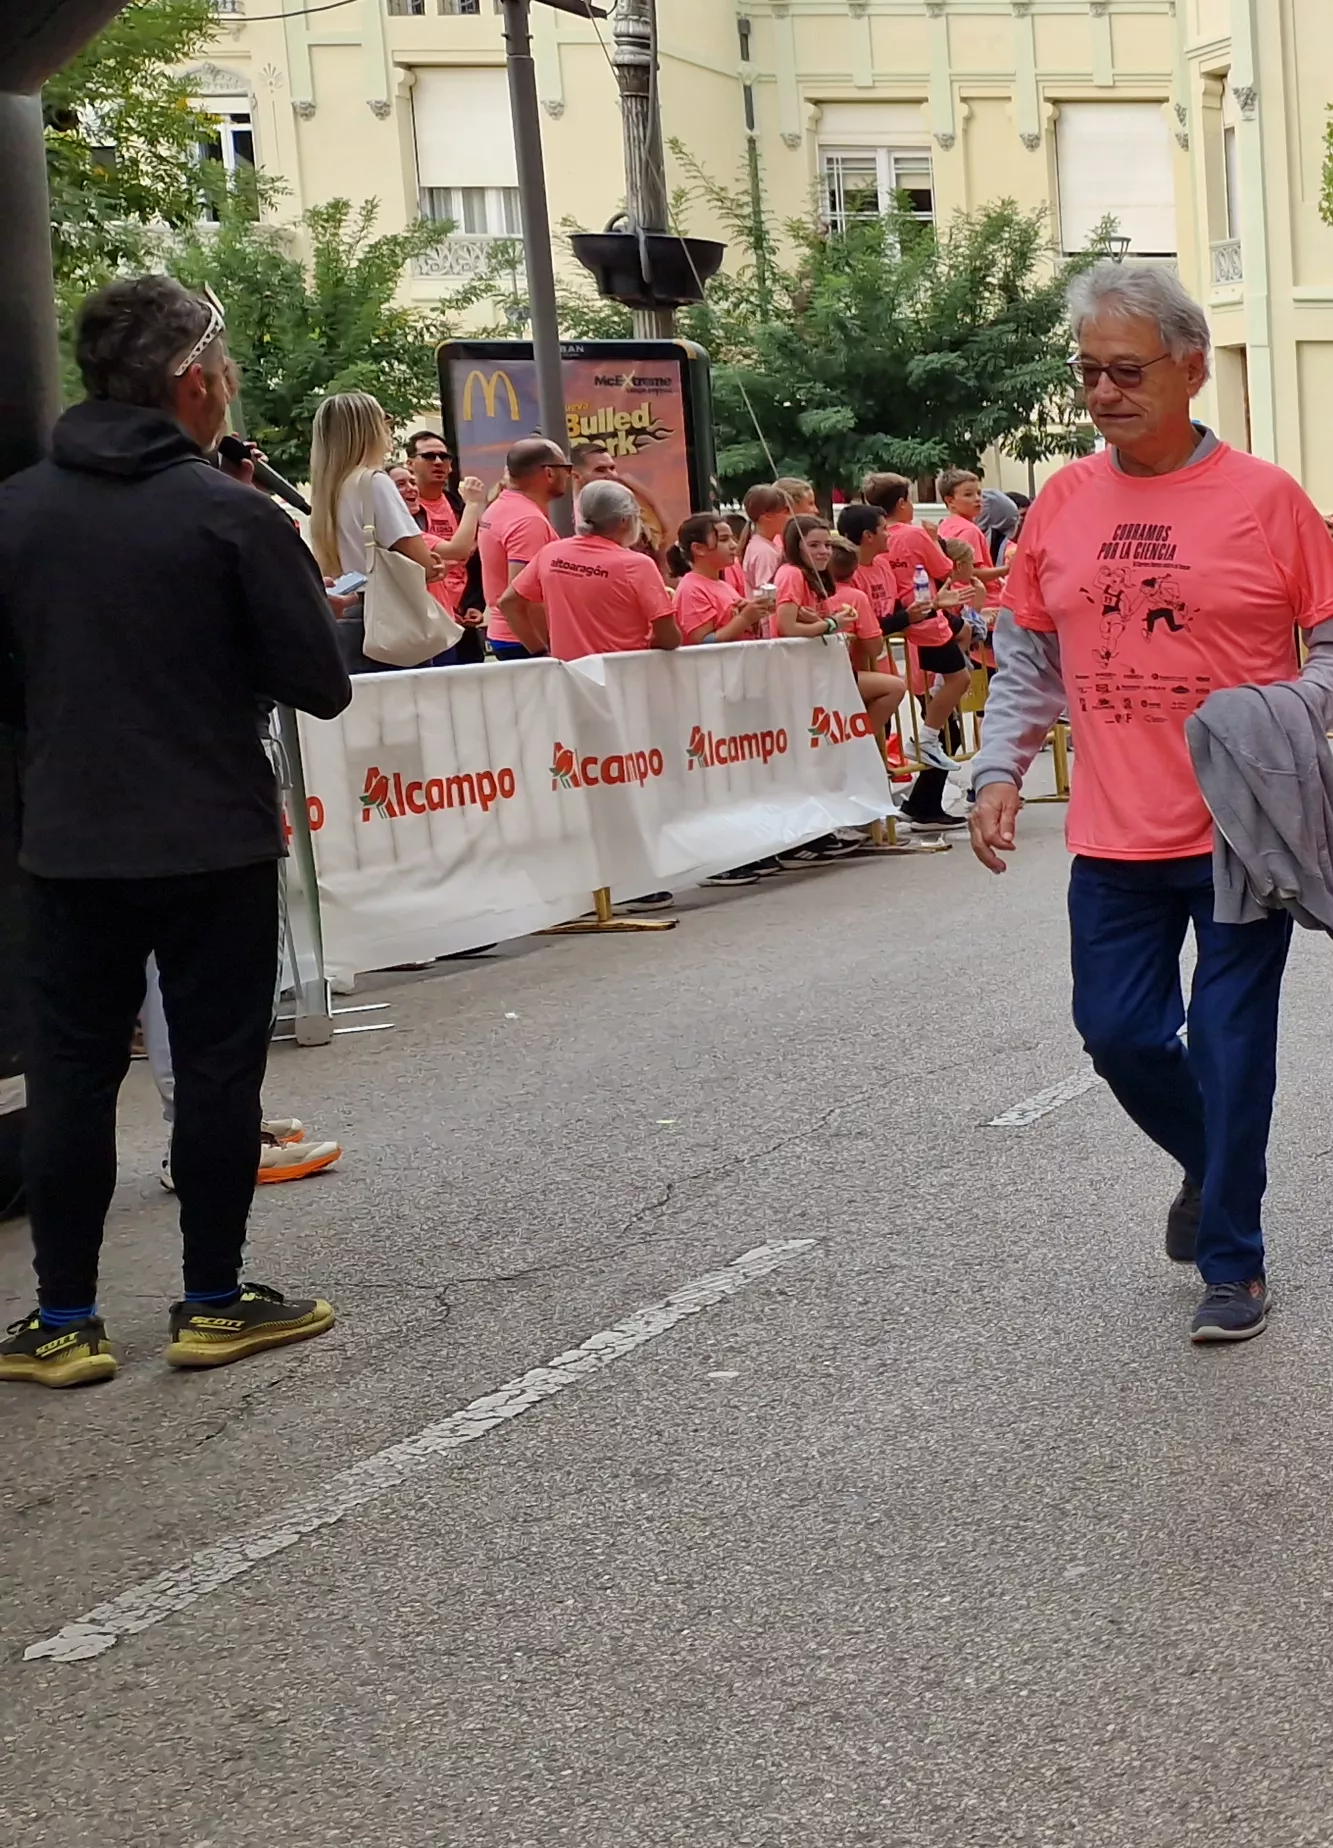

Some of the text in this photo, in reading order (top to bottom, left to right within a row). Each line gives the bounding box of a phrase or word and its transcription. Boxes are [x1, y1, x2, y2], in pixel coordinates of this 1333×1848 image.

[566, 402, 652, 438] Bulled
[1112, 523, 1172, 542] CORRAMOS
[1097, 541, 1177, 561] POR LA CIENCIA
[686, 725, 788, 771] Alcampo
[359, 766, 516, 823] Alcampo
[189, 1316, 245, 1328] SCOTT
